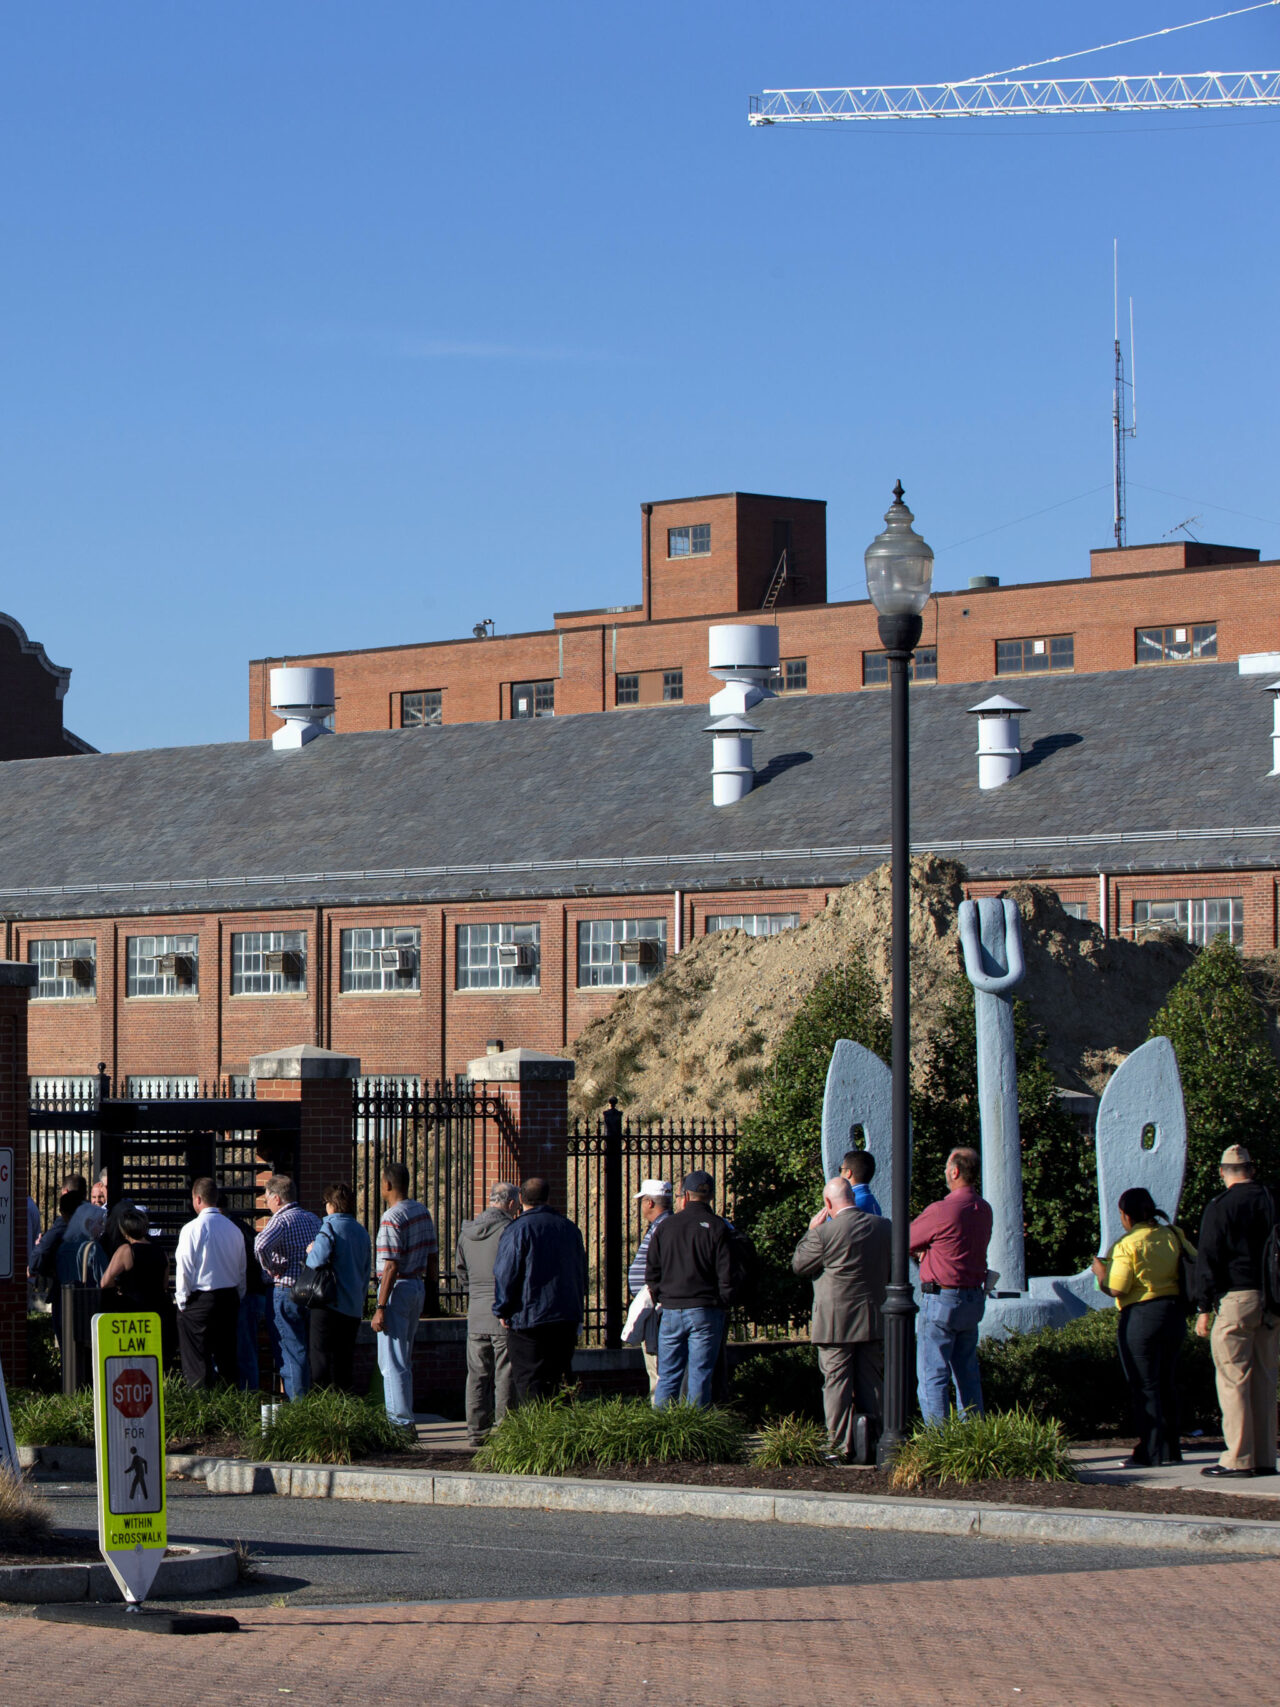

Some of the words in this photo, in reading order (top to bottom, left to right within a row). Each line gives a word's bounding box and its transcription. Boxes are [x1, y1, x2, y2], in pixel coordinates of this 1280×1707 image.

[111, 1319, 152, 1334] STATE
[118, 1337, 146, 1352] LAW
[114, 1383, 151, 1403] STOP
[124, 1428, 145, 1439] FOR
[123, 1517, 153, 1529] WITHIN
[111, 1531, 163, 1545] CROSSWALK
